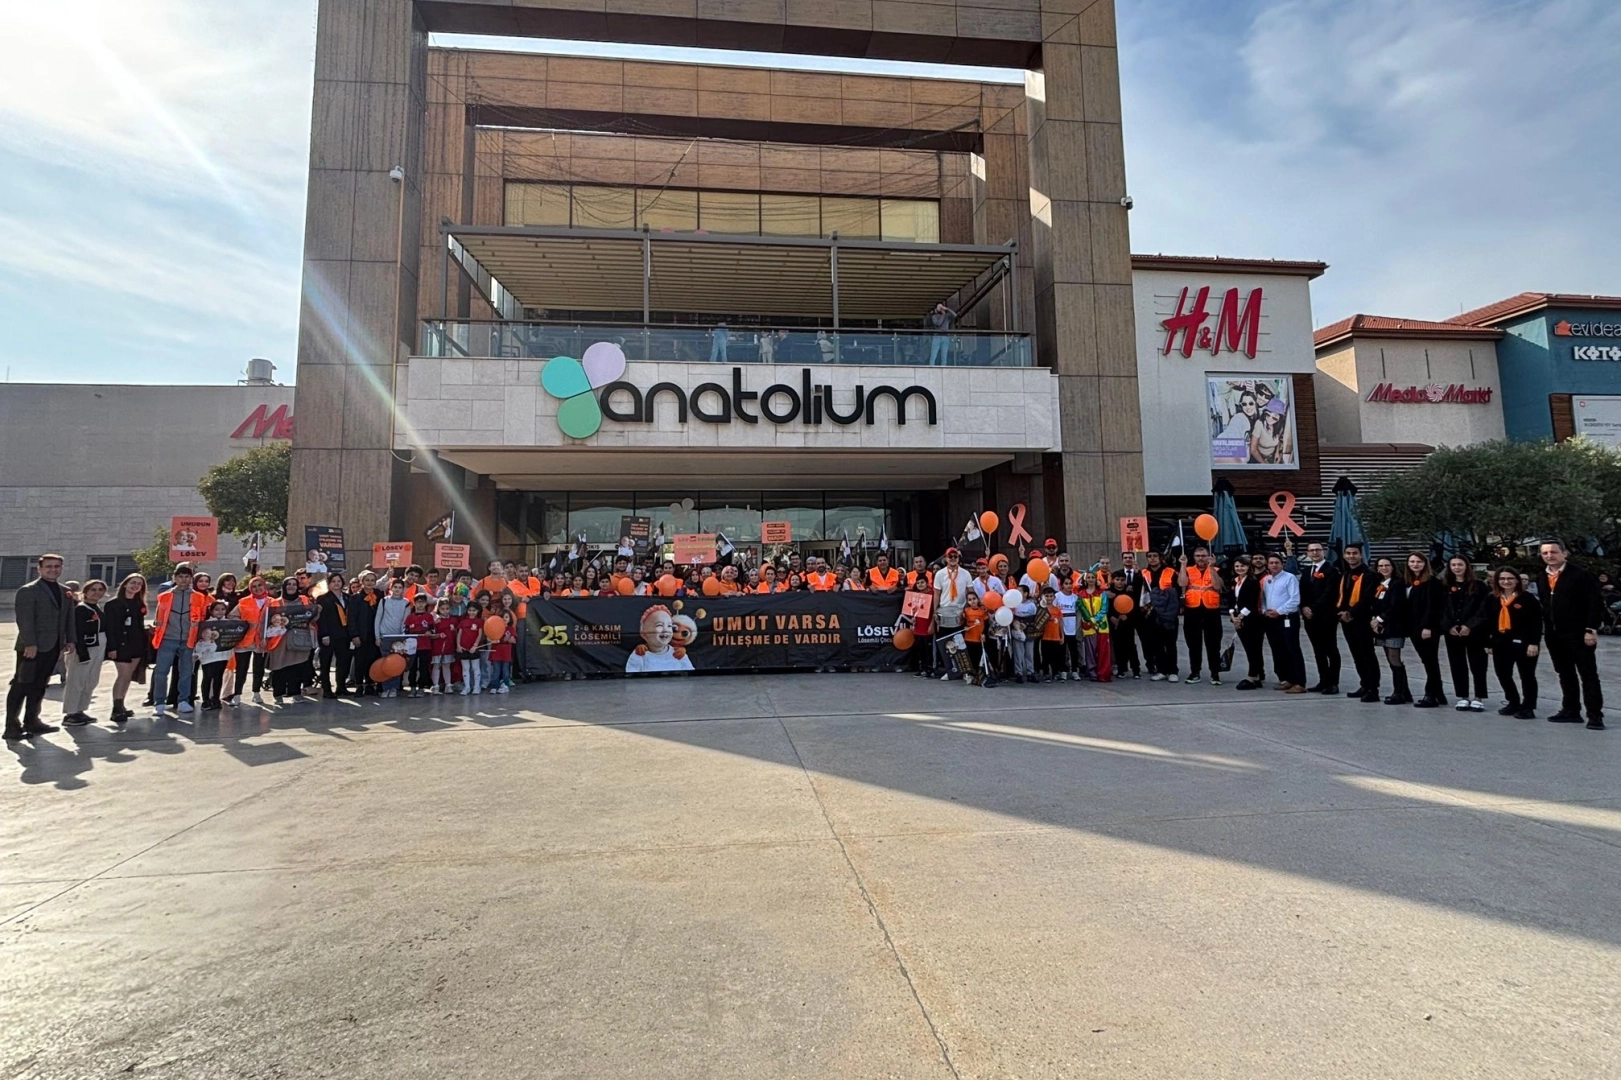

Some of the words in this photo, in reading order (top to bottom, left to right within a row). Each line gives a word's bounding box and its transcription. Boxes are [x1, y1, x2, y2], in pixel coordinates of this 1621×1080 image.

[1160, 286, 1263, 359] H&M
[1571, 321, 1621, 337] evidea
[599, 367, 938, 425] anatolium
[1366, 382, 1428, 404] Media
[1442, 383, 1493, 404] Markt
[713, 615, 769, 632] UMUT
[775, 614, 841, 630] VARSA
[857, 624, 898, 637] LÖSEV
[540, 625, 571, 645] 25.
[592, 624, 621, 632] KASIM
[574, 632, 621, 640] LÖSEMİLİ
[712, 633, 771, 648] İYİLEŞME
[774, 634, 789, 645] DE
[794, 633, 841, 645] VARDIR
